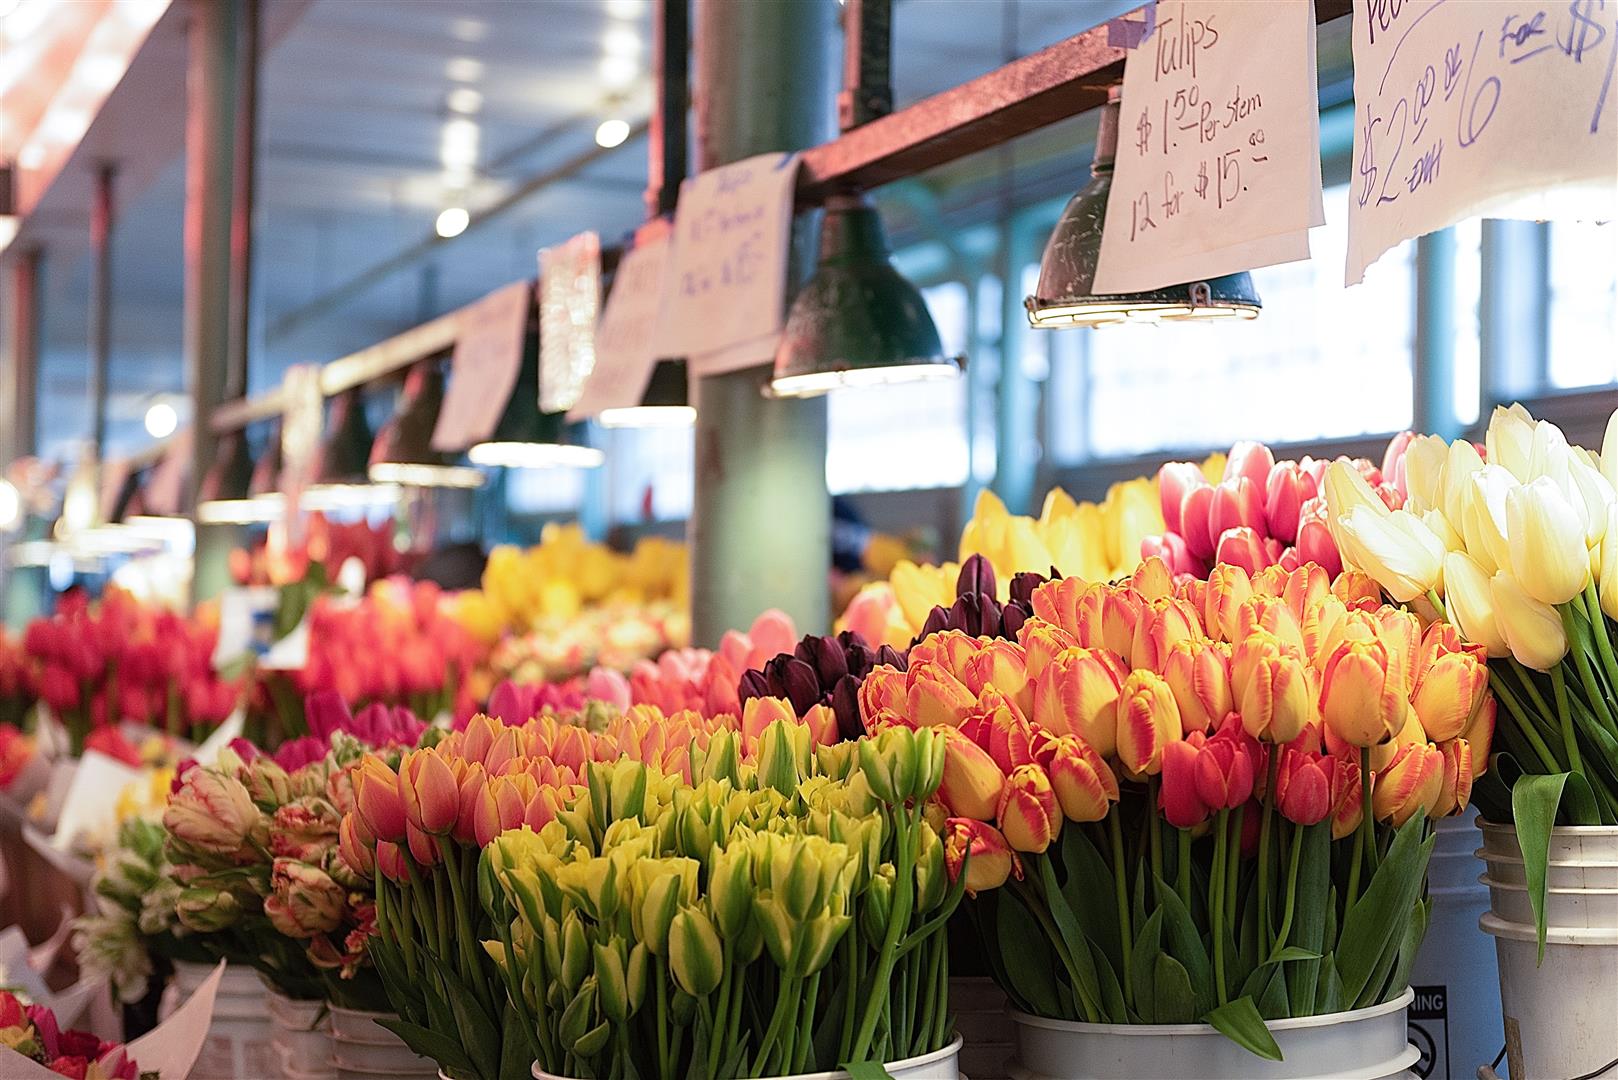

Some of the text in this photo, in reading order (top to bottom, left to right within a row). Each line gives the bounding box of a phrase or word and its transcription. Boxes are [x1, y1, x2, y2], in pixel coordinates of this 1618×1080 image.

[1153, 3, 1219, 82] Tulips
[1223, 85, 1262, 129] stem
[1457, 30, 1501, 148] 6
[1130, 191, 1157, 242] 12
[1161, 170, 1184, 219] for
